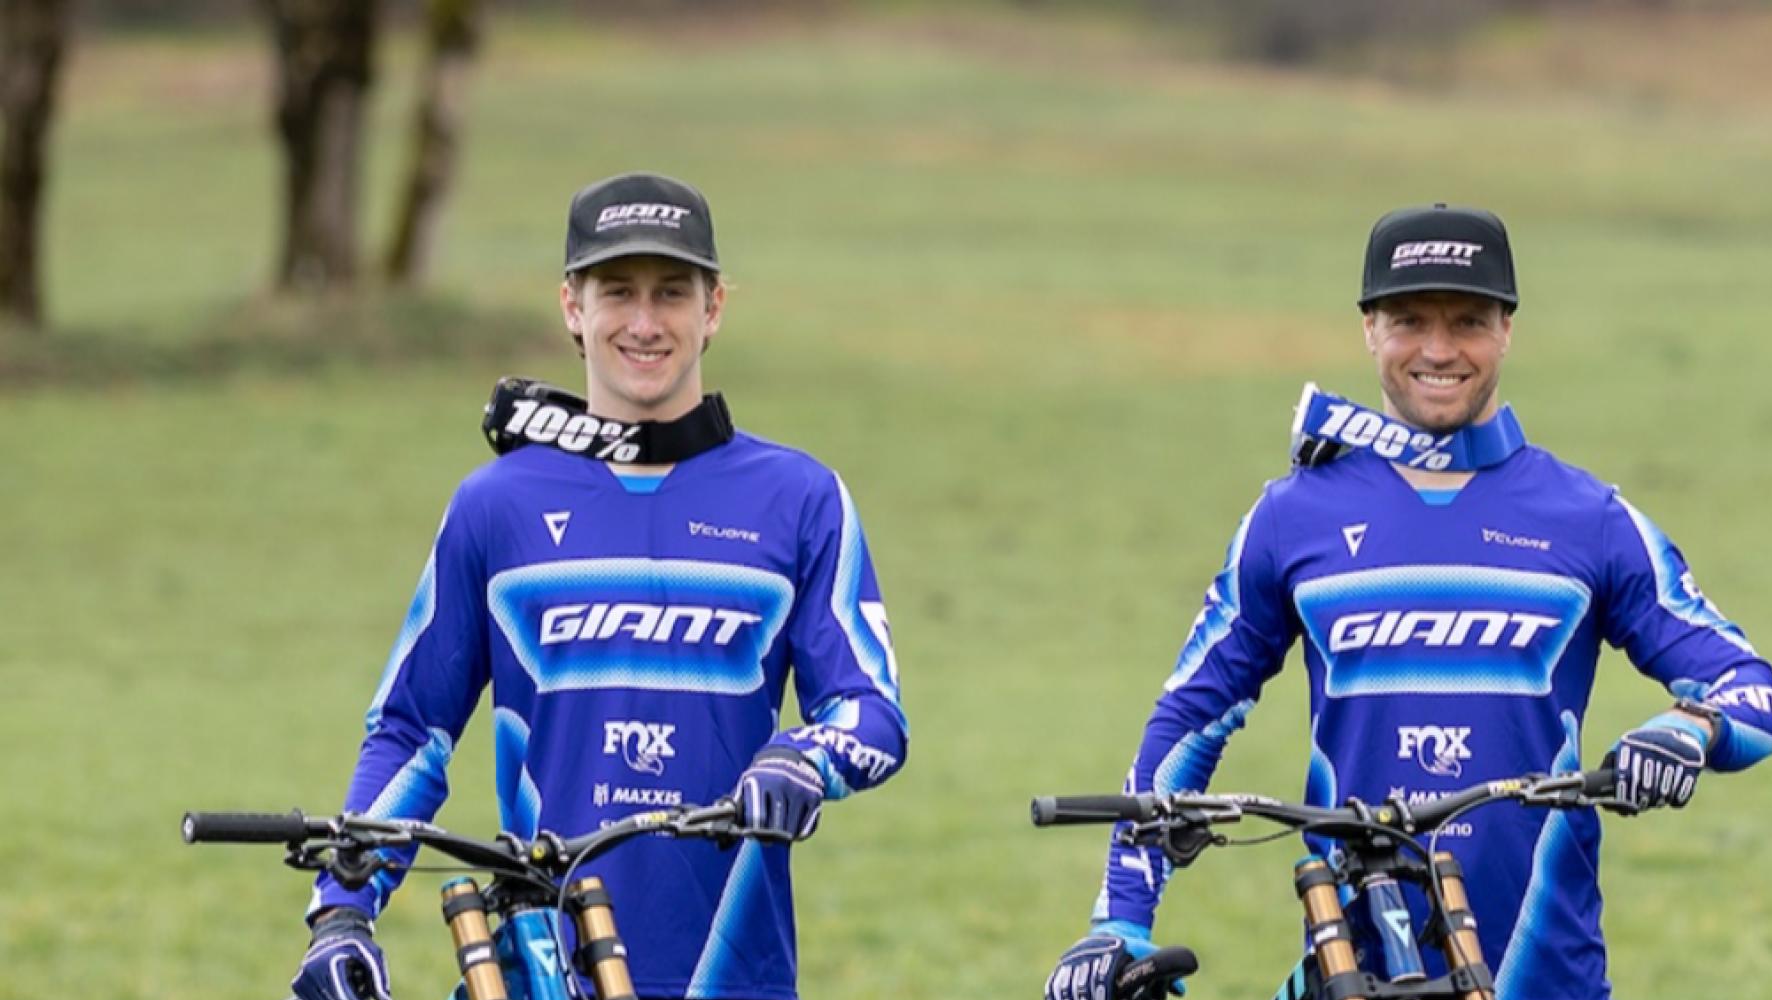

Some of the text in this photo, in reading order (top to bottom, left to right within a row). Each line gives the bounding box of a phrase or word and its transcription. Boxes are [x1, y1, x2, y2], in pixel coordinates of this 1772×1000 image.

[598, 203, 691, 223] GIANT
[1392, 240, 1483, 259] GIANT
[505, 399, 641, 462] 100%
[1318, 403, 1453, 470] 100%
[540, 603, 763, 645] GIANT
[1329, 610, 1562, 653] GIANT
[603, 720, 676, 776] FOX
[1398, 725, 1472, 778] FOX
[612, 786, 682, 805] MAXXIS
